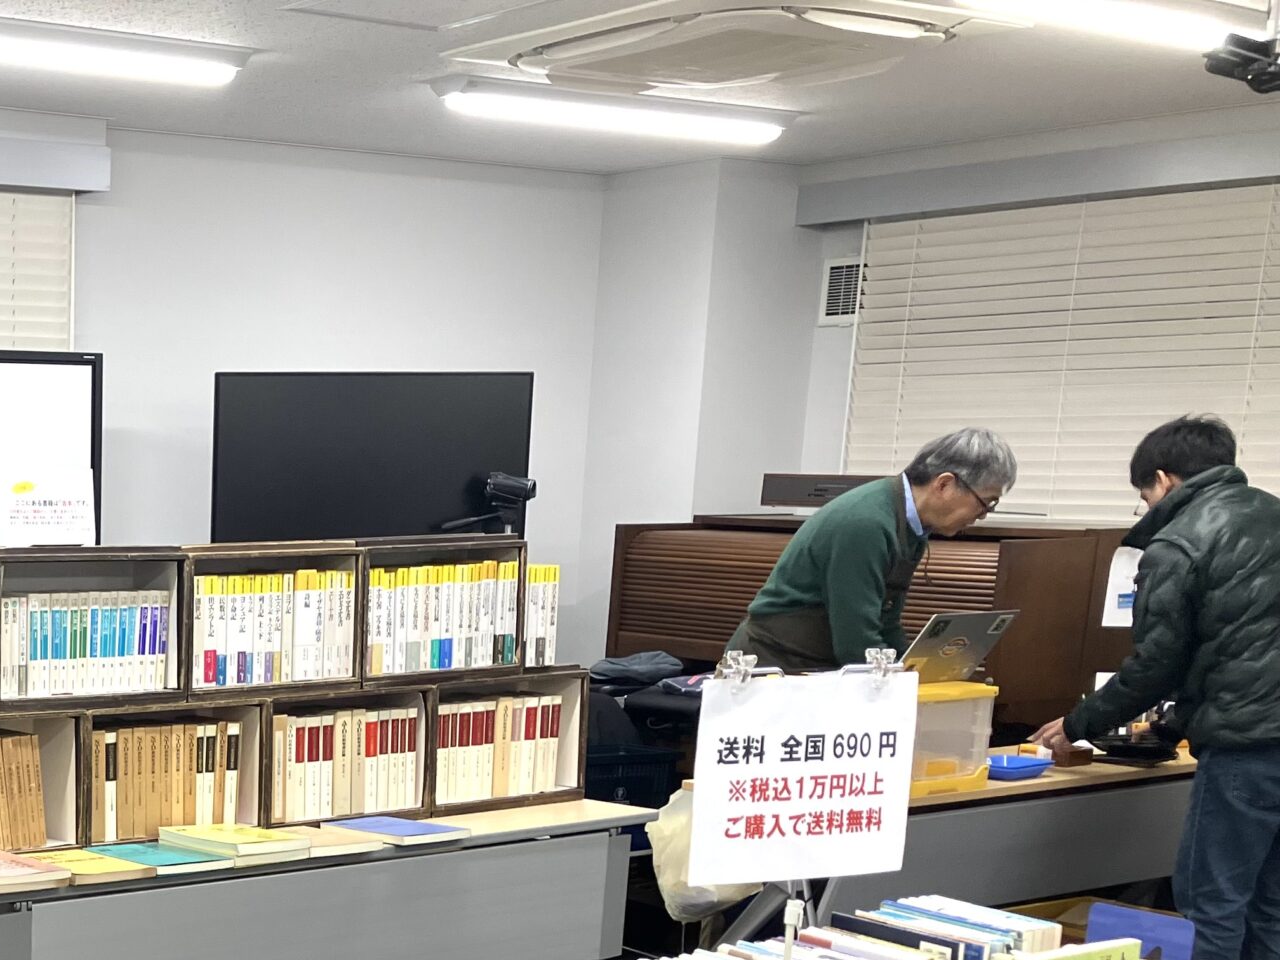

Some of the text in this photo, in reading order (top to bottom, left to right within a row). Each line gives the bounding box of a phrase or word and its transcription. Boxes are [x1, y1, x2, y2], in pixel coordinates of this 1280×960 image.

[717, 731, 897, 764] 送料 全国 690 円
[728, 771, 884, 802] ※税込1万円以上
[724, 807, 882, 839] ご購入で送料無料
